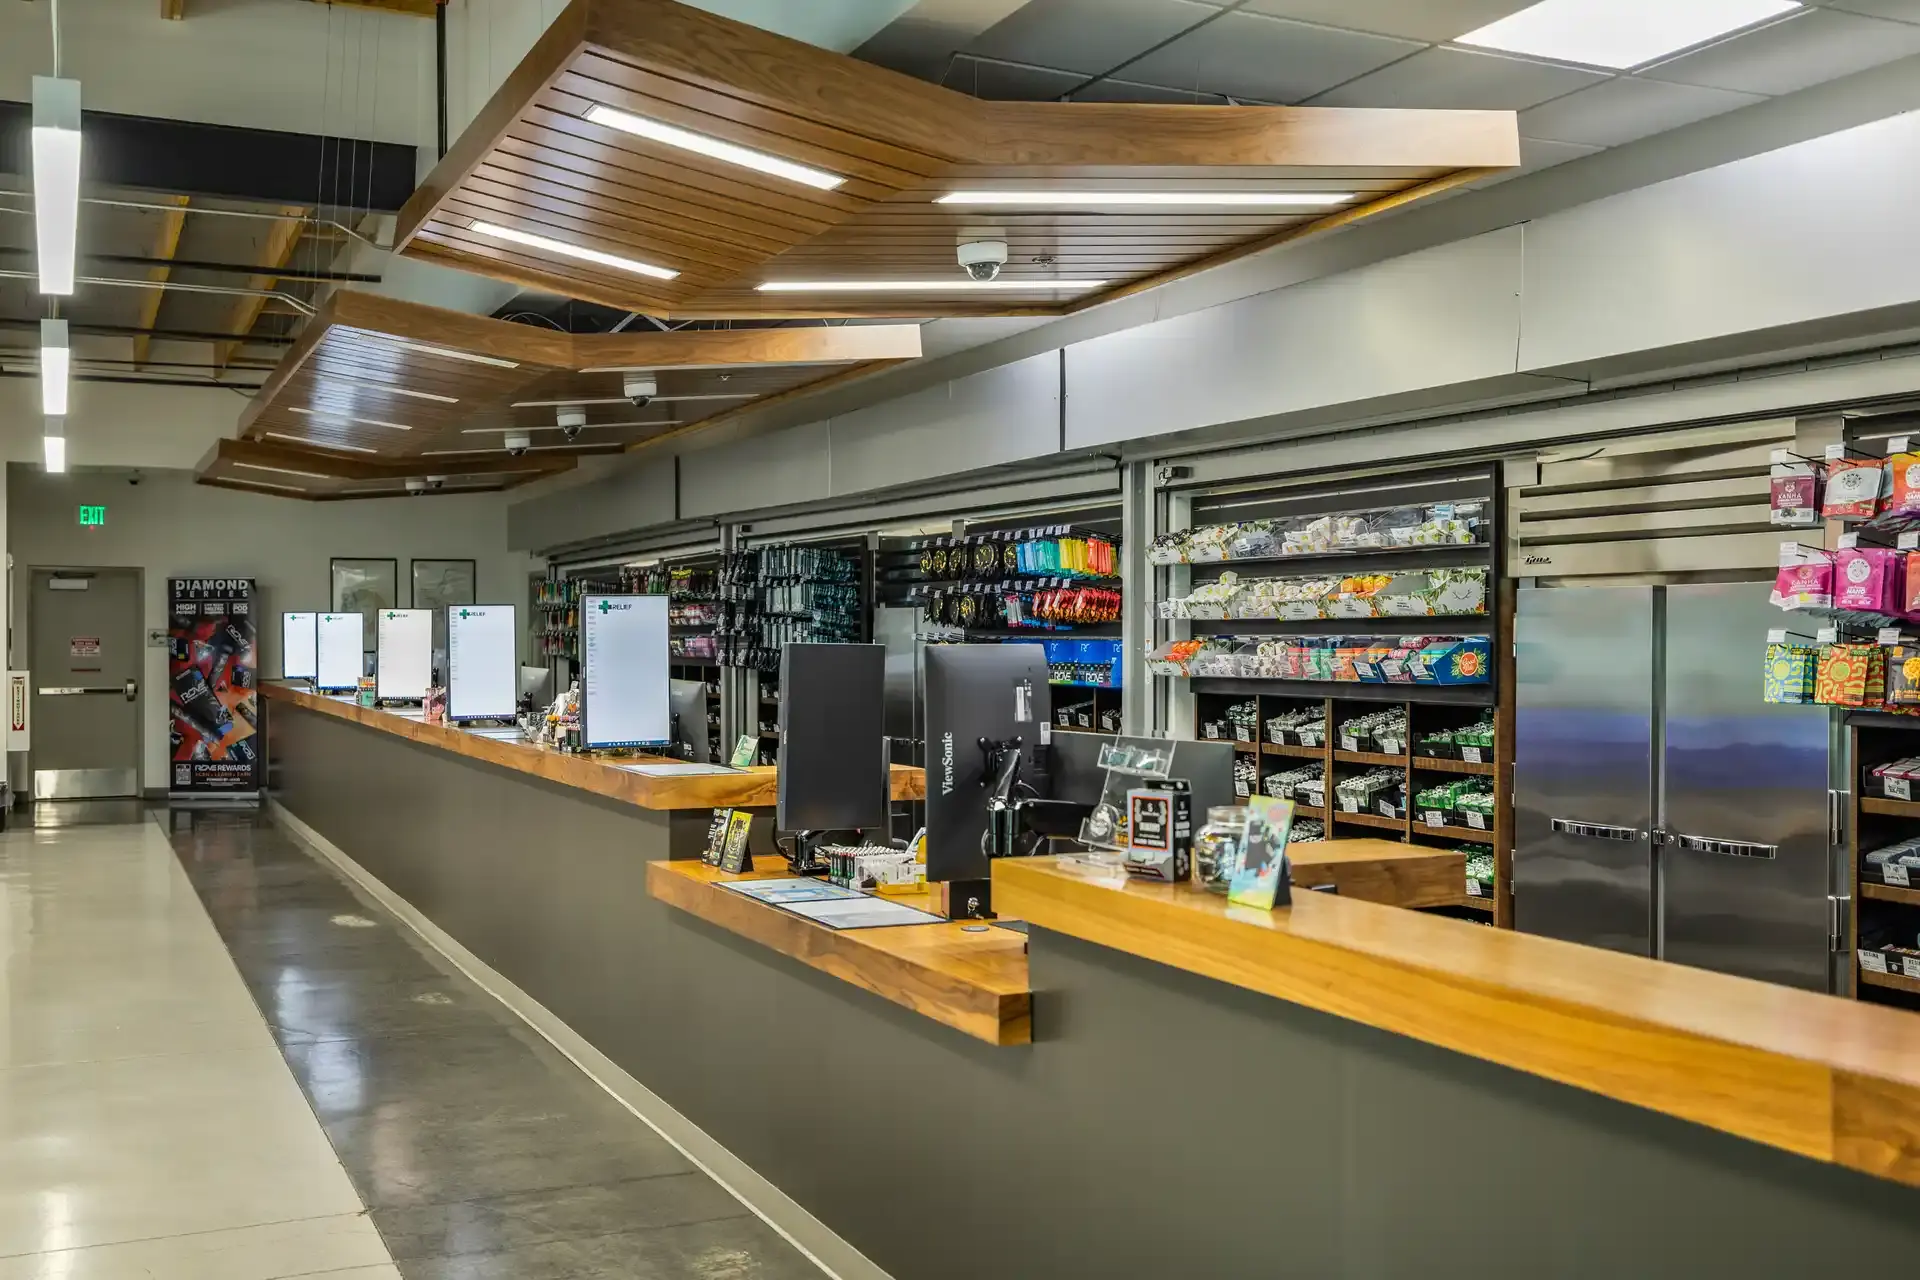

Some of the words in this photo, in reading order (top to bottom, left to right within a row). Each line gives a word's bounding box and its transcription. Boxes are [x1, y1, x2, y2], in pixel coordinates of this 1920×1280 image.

[79, 505, 105, 525] EXIT
[175, 579, 249, 591] DIAMOND
[175, 590, 248, 598] SERIES
[175, 603, 197, 611] HIGH
[1053, 671, 1072, 681] ROVE
[1085, 672, 1104, 683] ROVE
[217, 764, 252, 772] REWARDS
[942, 732, 953, 796] ViewSonic
